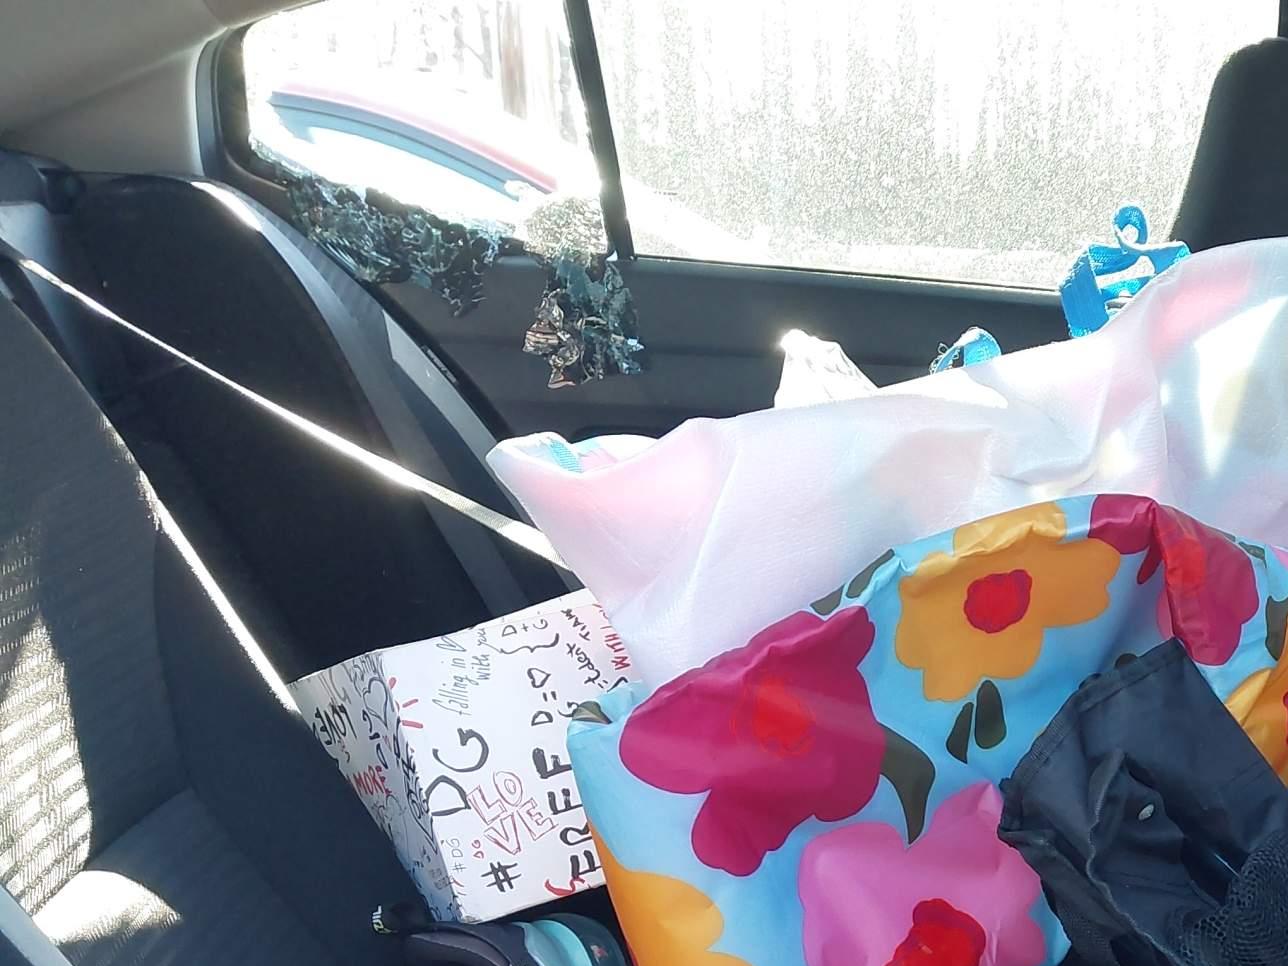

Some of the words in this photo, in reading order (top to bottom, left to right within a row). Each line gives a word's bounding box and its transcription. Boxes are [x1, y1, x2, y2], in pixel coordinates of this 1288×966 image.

[470, 653, 491, 682] with
[604, 633, 631, 671] WITH
[432, 669, 472, 717] falling
[353, 764, 392, 797] MORE
